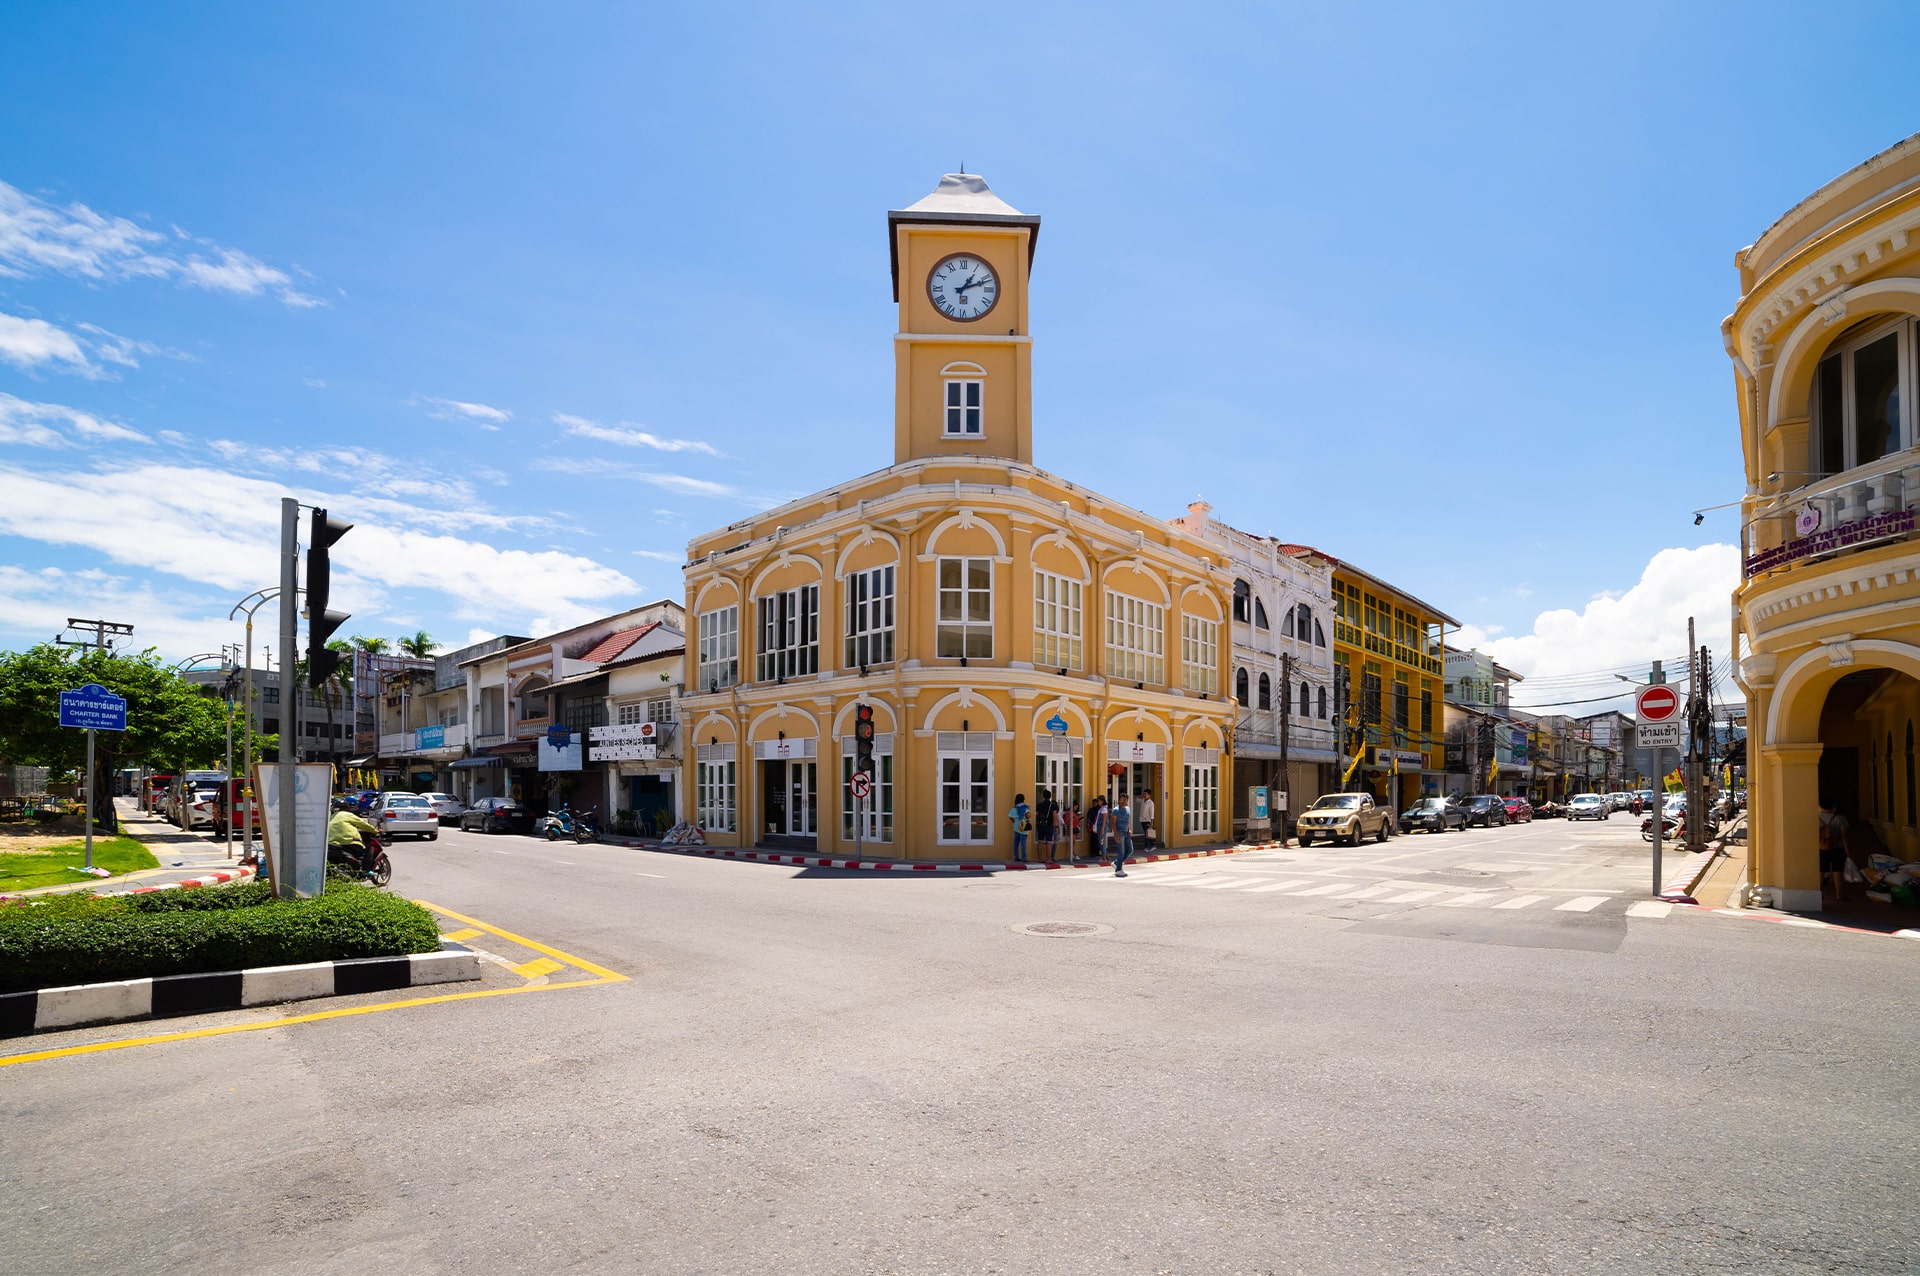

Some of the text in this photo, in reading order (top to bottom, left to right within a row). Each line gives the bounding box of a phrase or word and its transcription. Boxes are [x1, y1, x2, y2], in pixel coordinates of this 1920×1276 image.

[1841, 519, 1915, 546] MUSEUM
[70, 709, 118, 720] CHARTER BANK
[1640, 725, 1677, 737] ห้ามเข้า
